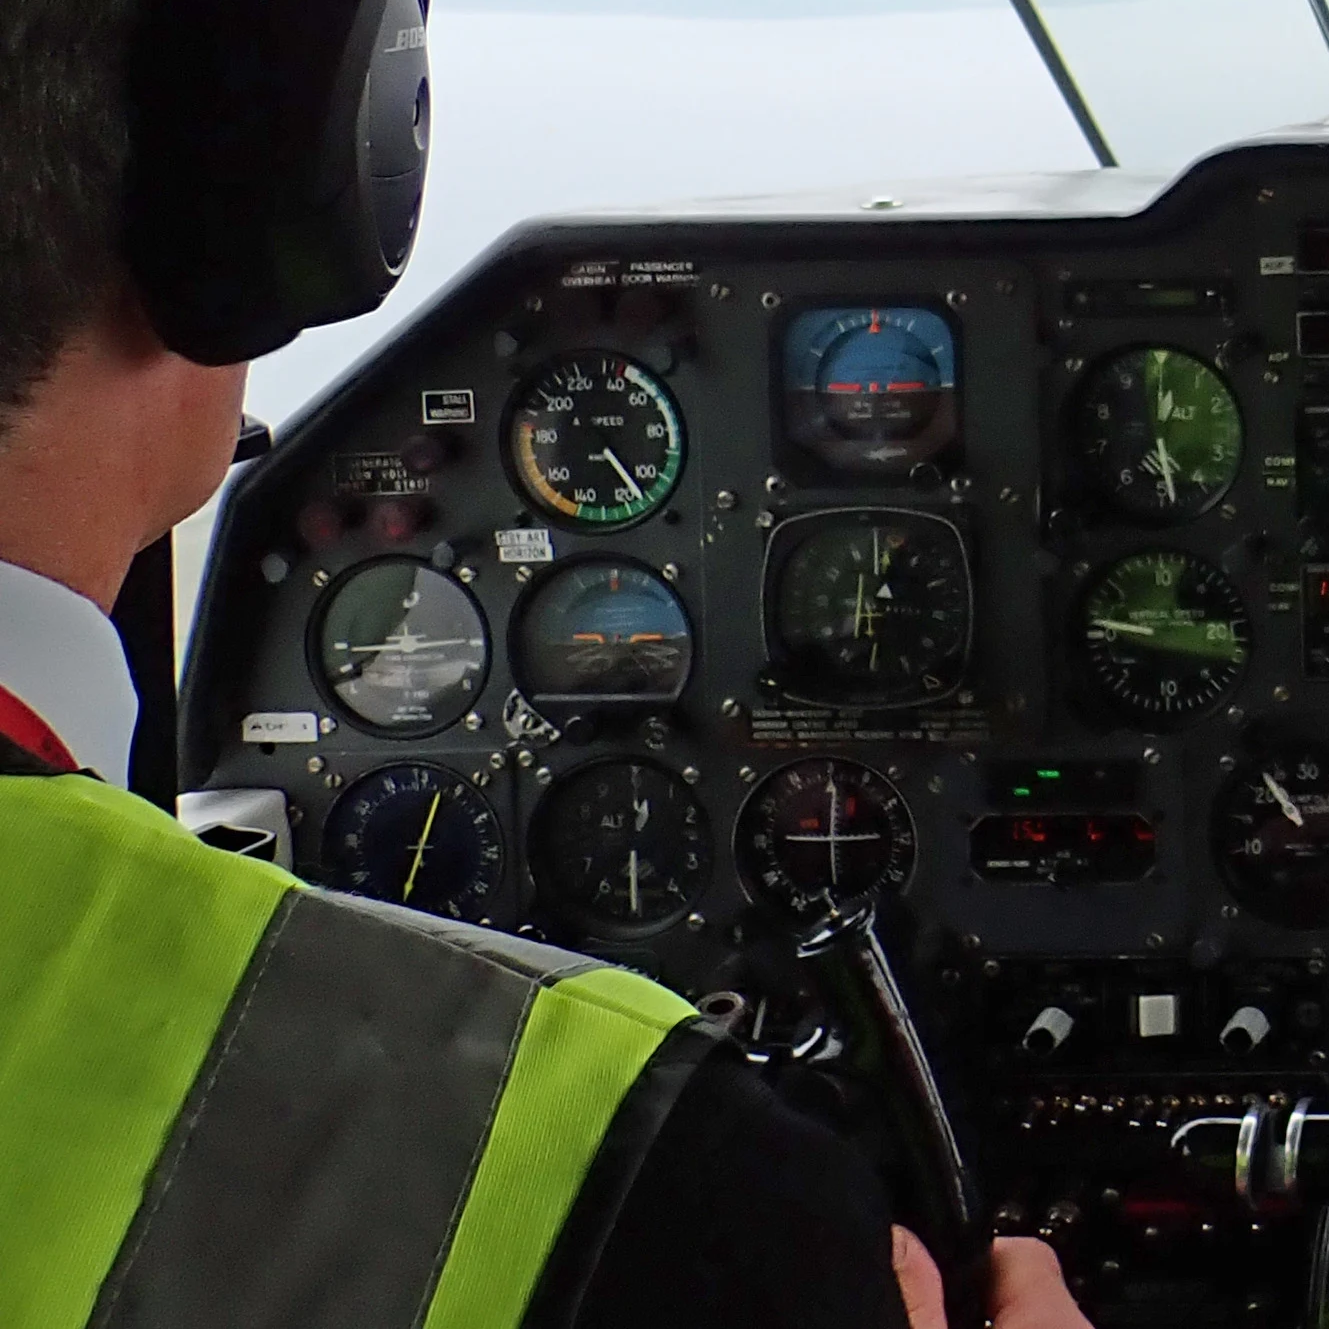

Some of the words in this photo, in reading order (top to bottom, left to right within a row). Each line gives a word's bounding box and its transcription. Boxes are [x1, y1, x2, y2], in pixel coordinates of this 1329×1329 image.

[567, 377, 593, 392] 220
[606, 378, 626, 392] 40
[1120, 373, 1133, 390] 9
[546, 396, 574, 412] 200
[628, 392, 648, 406] 60
[1210, 396, 1224, 413] 2
[1097, 403, 1110, 420] 8
[1171, 405, 1197, 420] ALT
[536, 430, 558, 444] 180
[647, 424, 664, 438] 80
[1211, 444, 1224, 461] 3
[548, 466, 570, 481] 160
[635, 465, 657, 478] 100
[1120, 469, 1133, 485] 6
[574, 488, 597, 503] 140
[615, 488, 636, 502] 120
[1154, 570, 1172, 587] 10
[1104, 628, 1117, 642] 0
[1206, 623, 1227, 640] 20
[1160, 680, 1178, 697] 10
[1296, 763, 1319, 780] 30
[600, 812, 624, 829] ALT
[685, 805, 697, 824] 2
[1244, 838, 1262, 855] 10
[686, 852, 699, 870] 3
